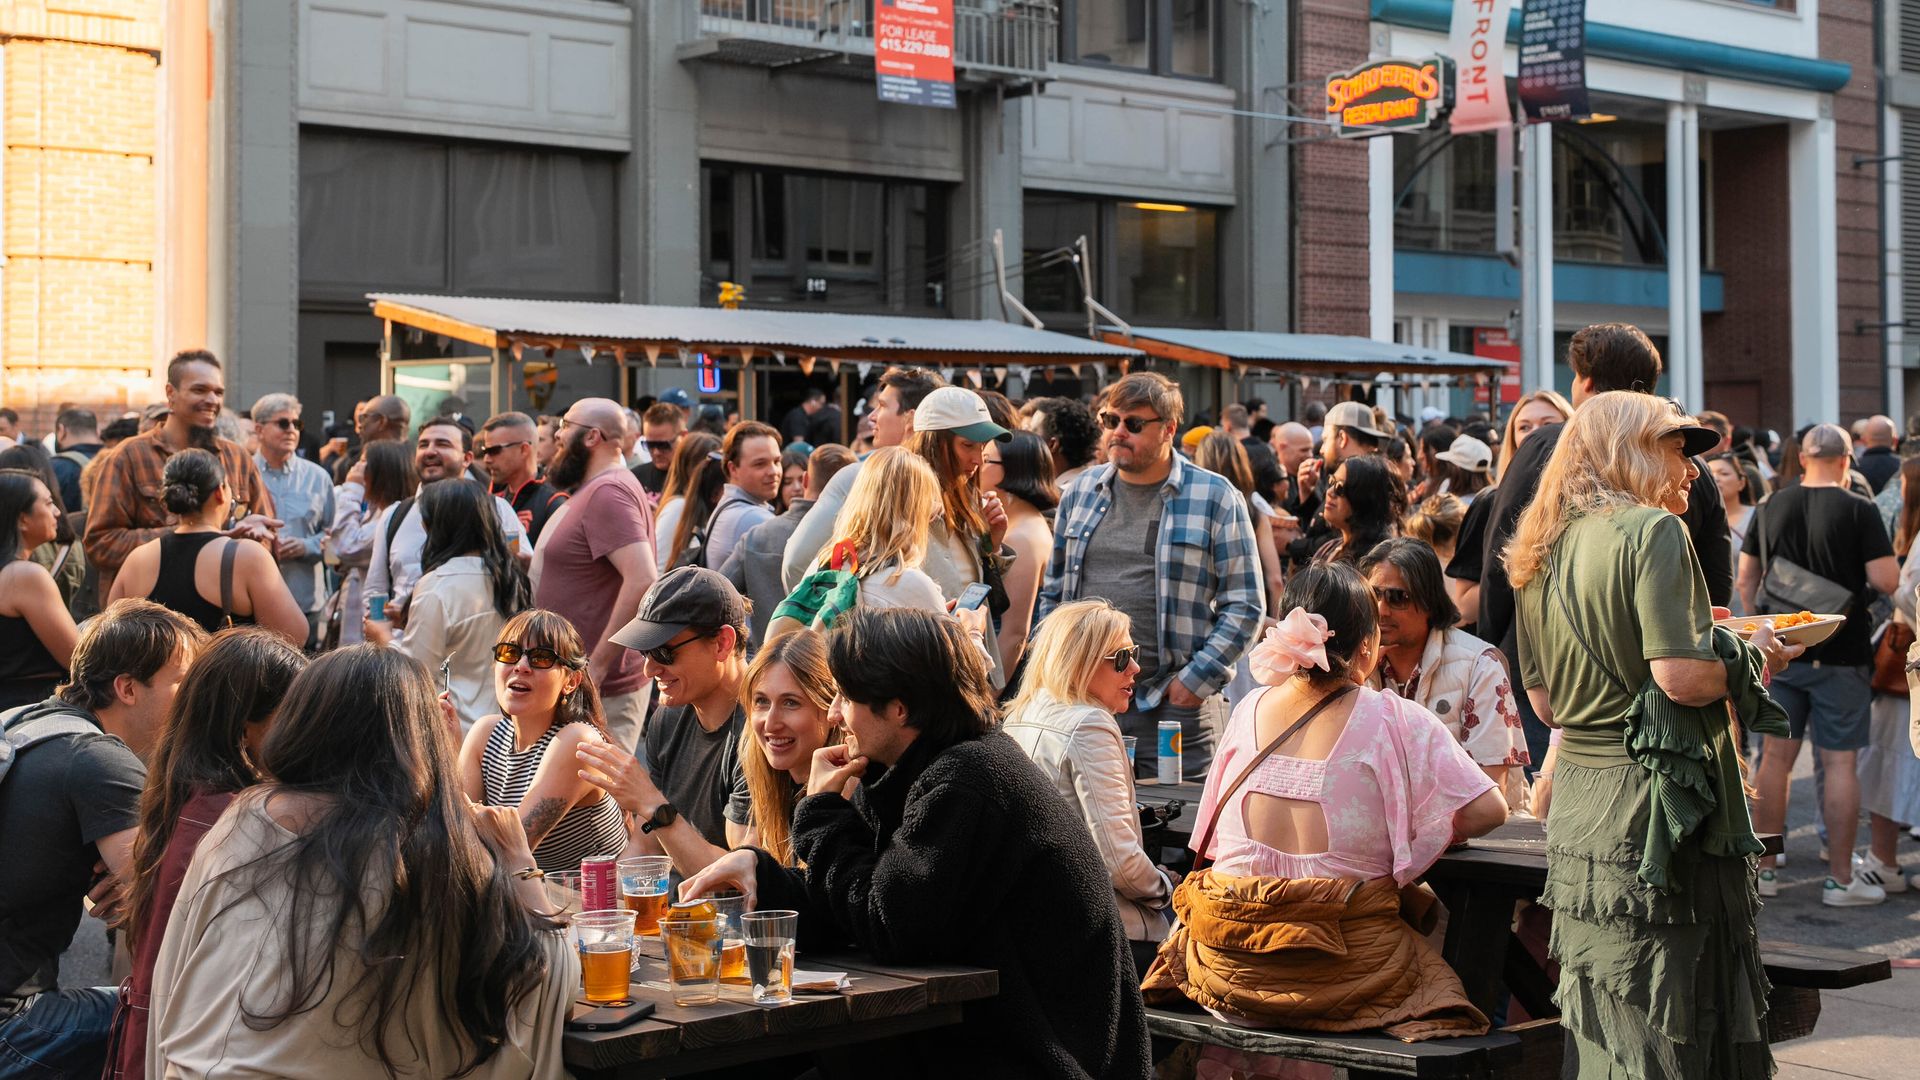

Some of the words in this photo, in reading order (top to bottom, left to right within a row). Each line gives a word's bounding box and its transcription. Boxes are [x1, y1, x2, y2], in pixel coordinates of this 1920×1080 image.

[880, 24, 903, 38] FOR
[905, 27, 937, 43] LEASE
[1467, 0, 1494, 105] FRONT
[1343, 97, 1419, 126] RESTAURANT
